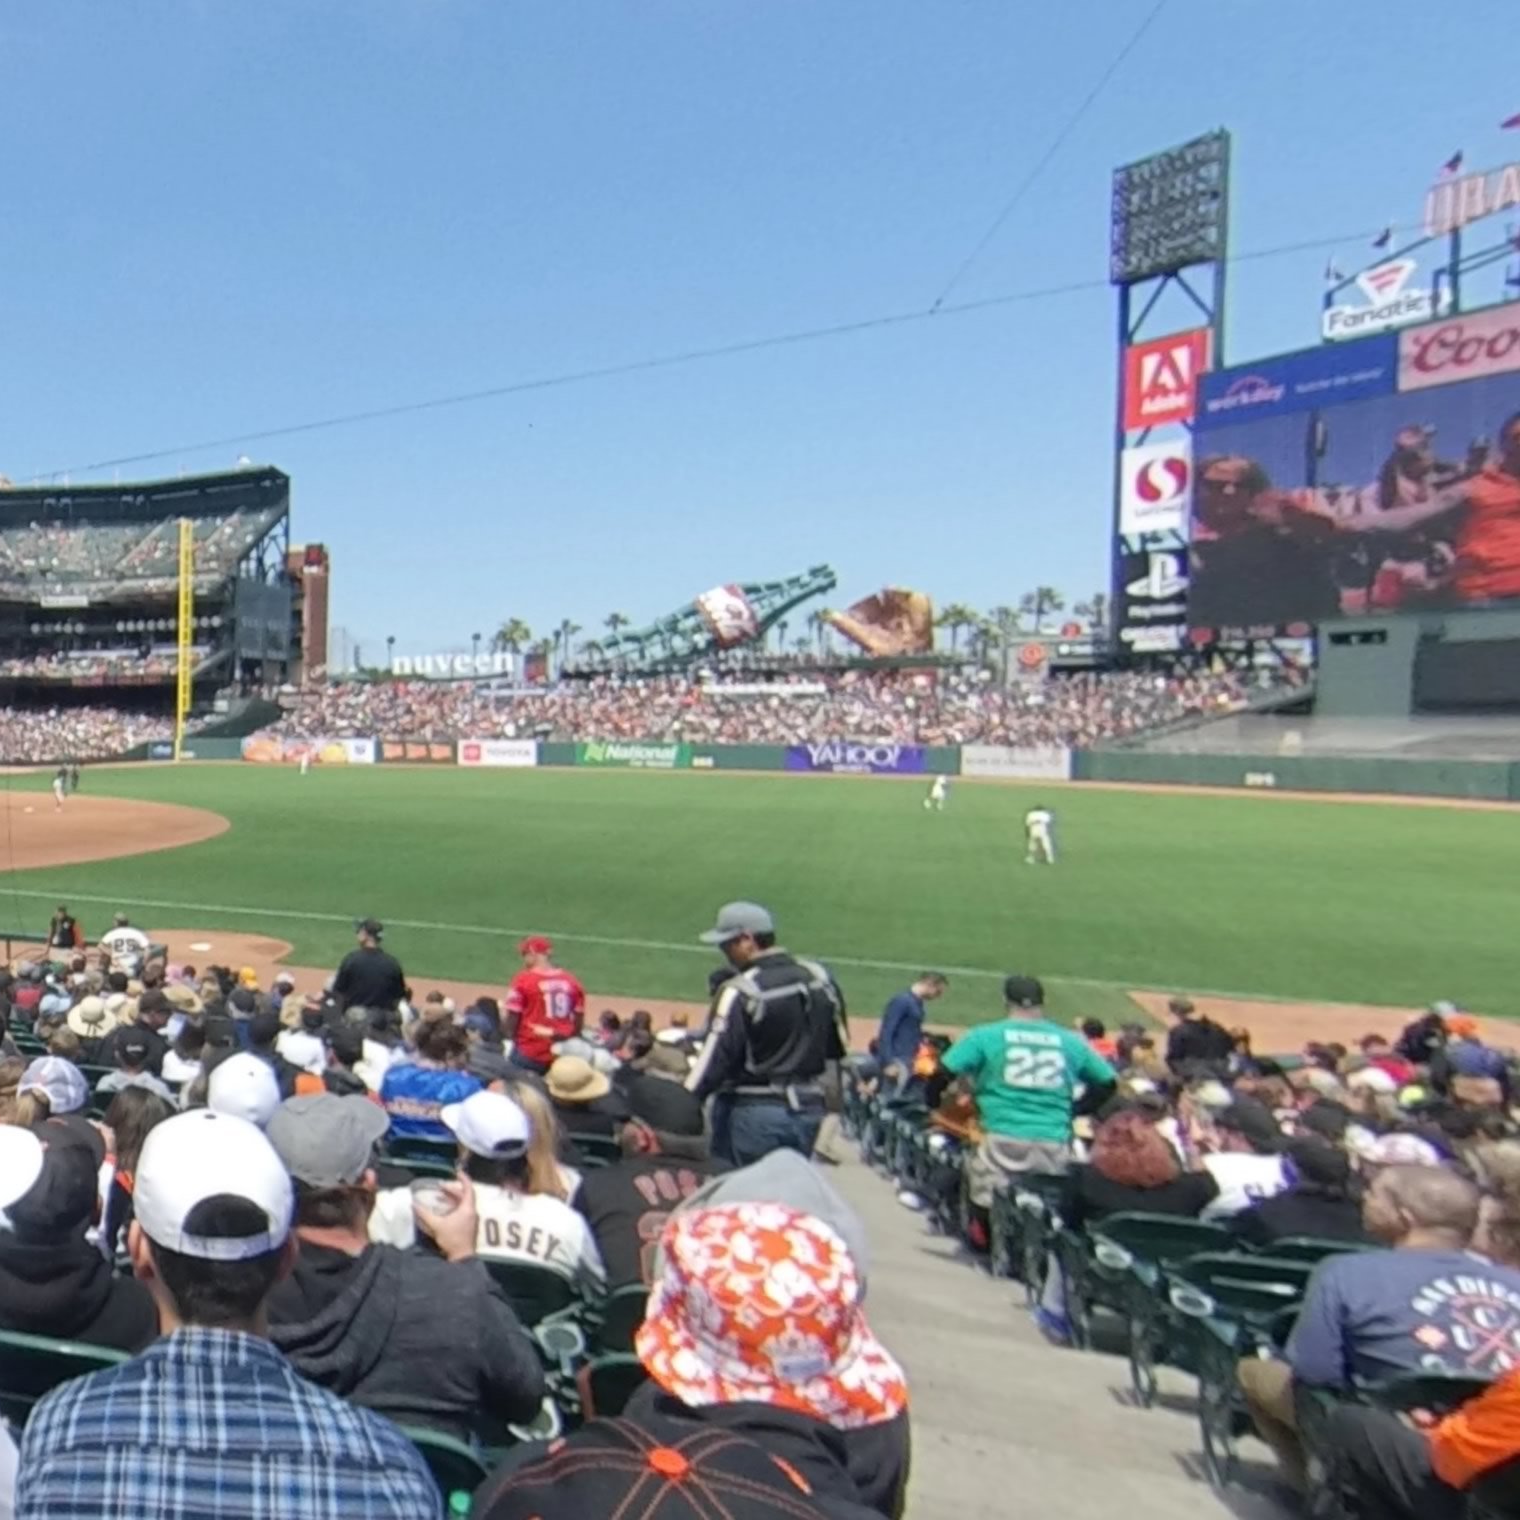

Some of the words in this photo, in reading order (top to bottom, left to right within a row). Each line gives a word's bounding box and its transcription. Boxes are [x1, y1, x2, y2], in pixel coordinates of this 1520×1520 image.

[391, 652, 516, 677] nuveen
[486, 747, 532, 758] TOYOTA
[604, 743, 679, 760] National
[806, 742, 902, 766] YAHOO!
[1003, 1046, 1066, 1088] 22
[483, 1217, 562, 1261] OSEY
